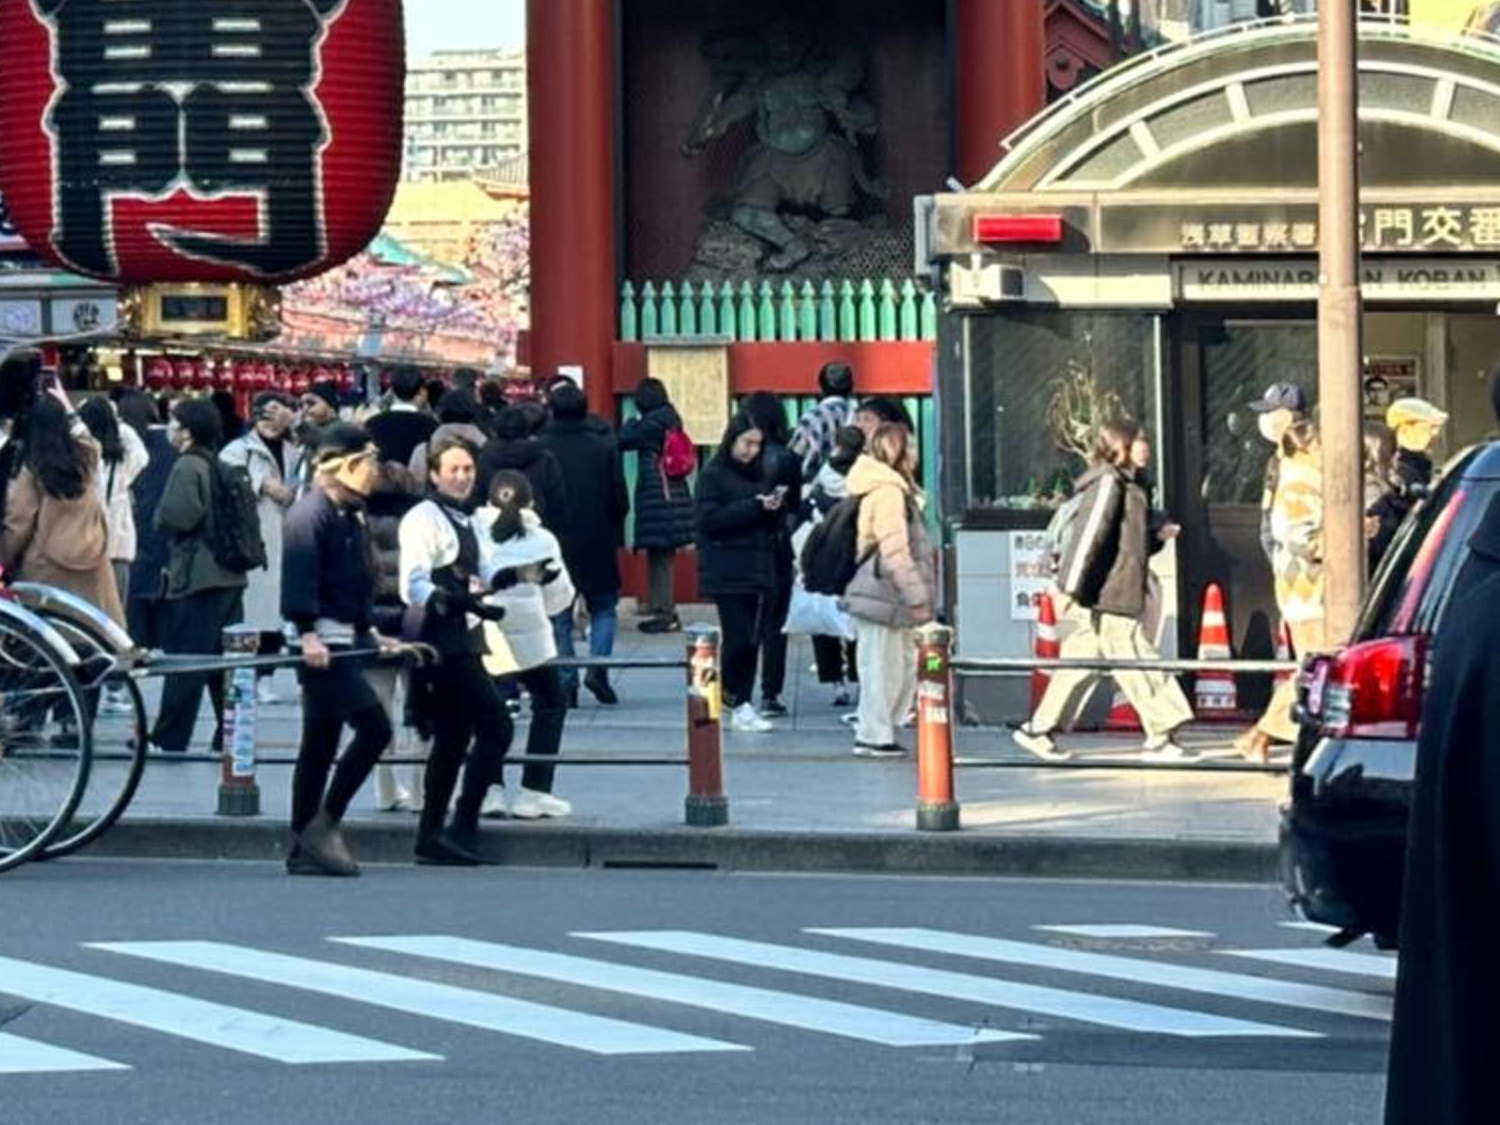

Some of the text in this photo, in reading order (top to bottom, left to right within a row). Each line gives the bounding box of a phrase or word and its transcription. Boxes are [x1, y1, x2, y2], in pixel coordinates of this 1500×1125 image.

[1359, 206, 1500, 245] 門交番
[1397, 269, 1486, 290] KOBAN
